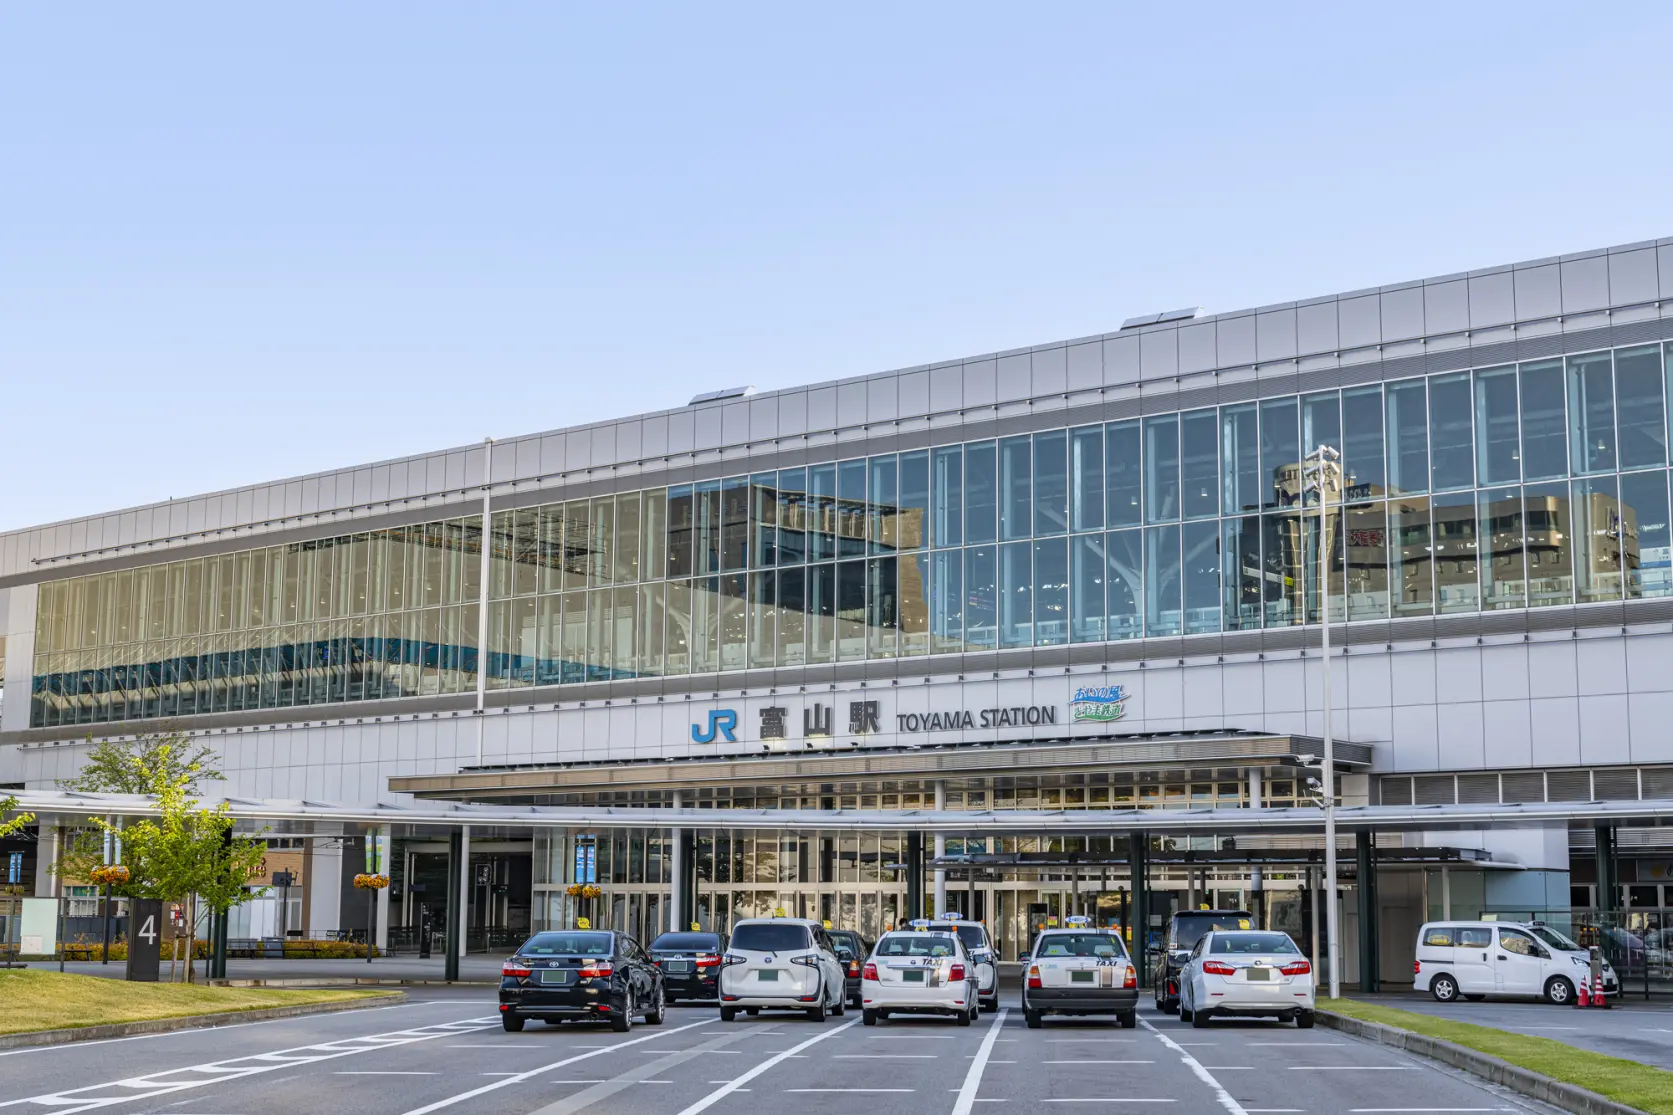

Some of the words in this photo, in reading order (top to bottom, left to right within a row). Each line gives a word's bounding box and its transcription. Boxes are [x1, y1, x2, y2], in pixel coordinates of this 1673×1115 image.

[692, 709, 737, 744] JR
[759, 700, 880, 739] 富山駅
[897, 711, 974, 732] TOYAMA
[980, 705, 1055, 728] STATION
[138, 914, 157, 945] 4
[922, 958, 943, 966] TAXI
